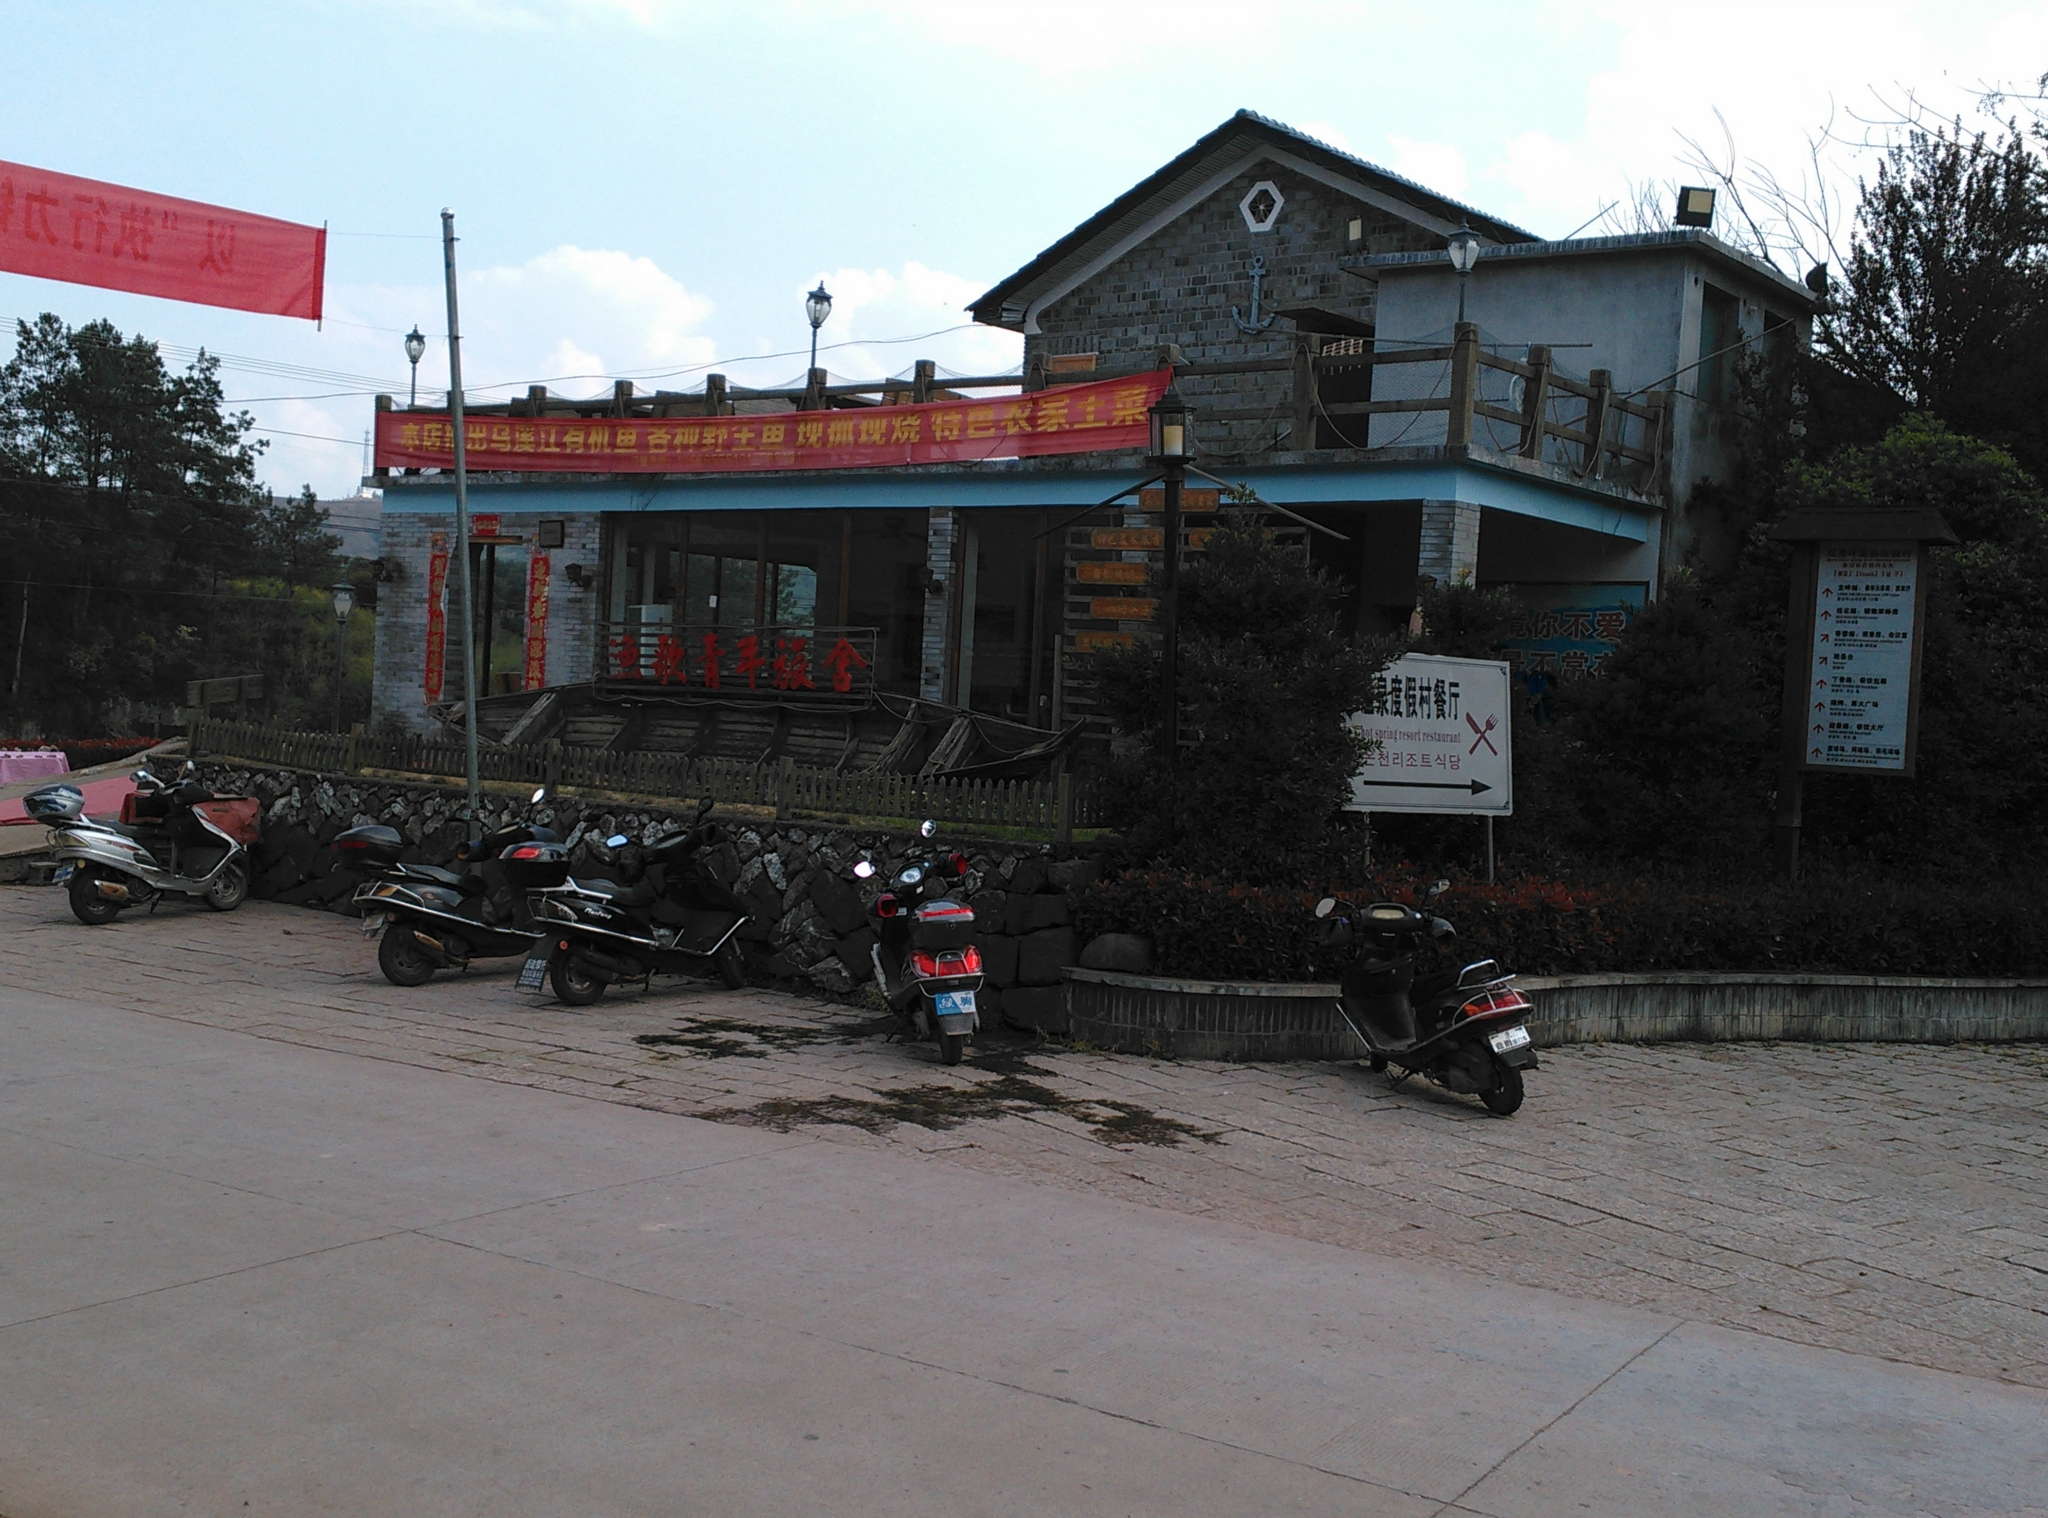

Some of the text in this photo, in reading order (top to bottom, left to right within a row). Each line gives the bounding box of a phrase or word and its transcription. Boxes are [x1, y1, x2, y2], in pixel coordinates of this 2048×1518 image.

[931, 385, 1148, 441] 特色农家土菜
[1362, 675, 1460, 720] 泉度假村餐厅
[1375, 729, 1398, 743] spring
[1399, 729, 1421, 742] resort
[1422, 730, 1461, 744] restaurant
